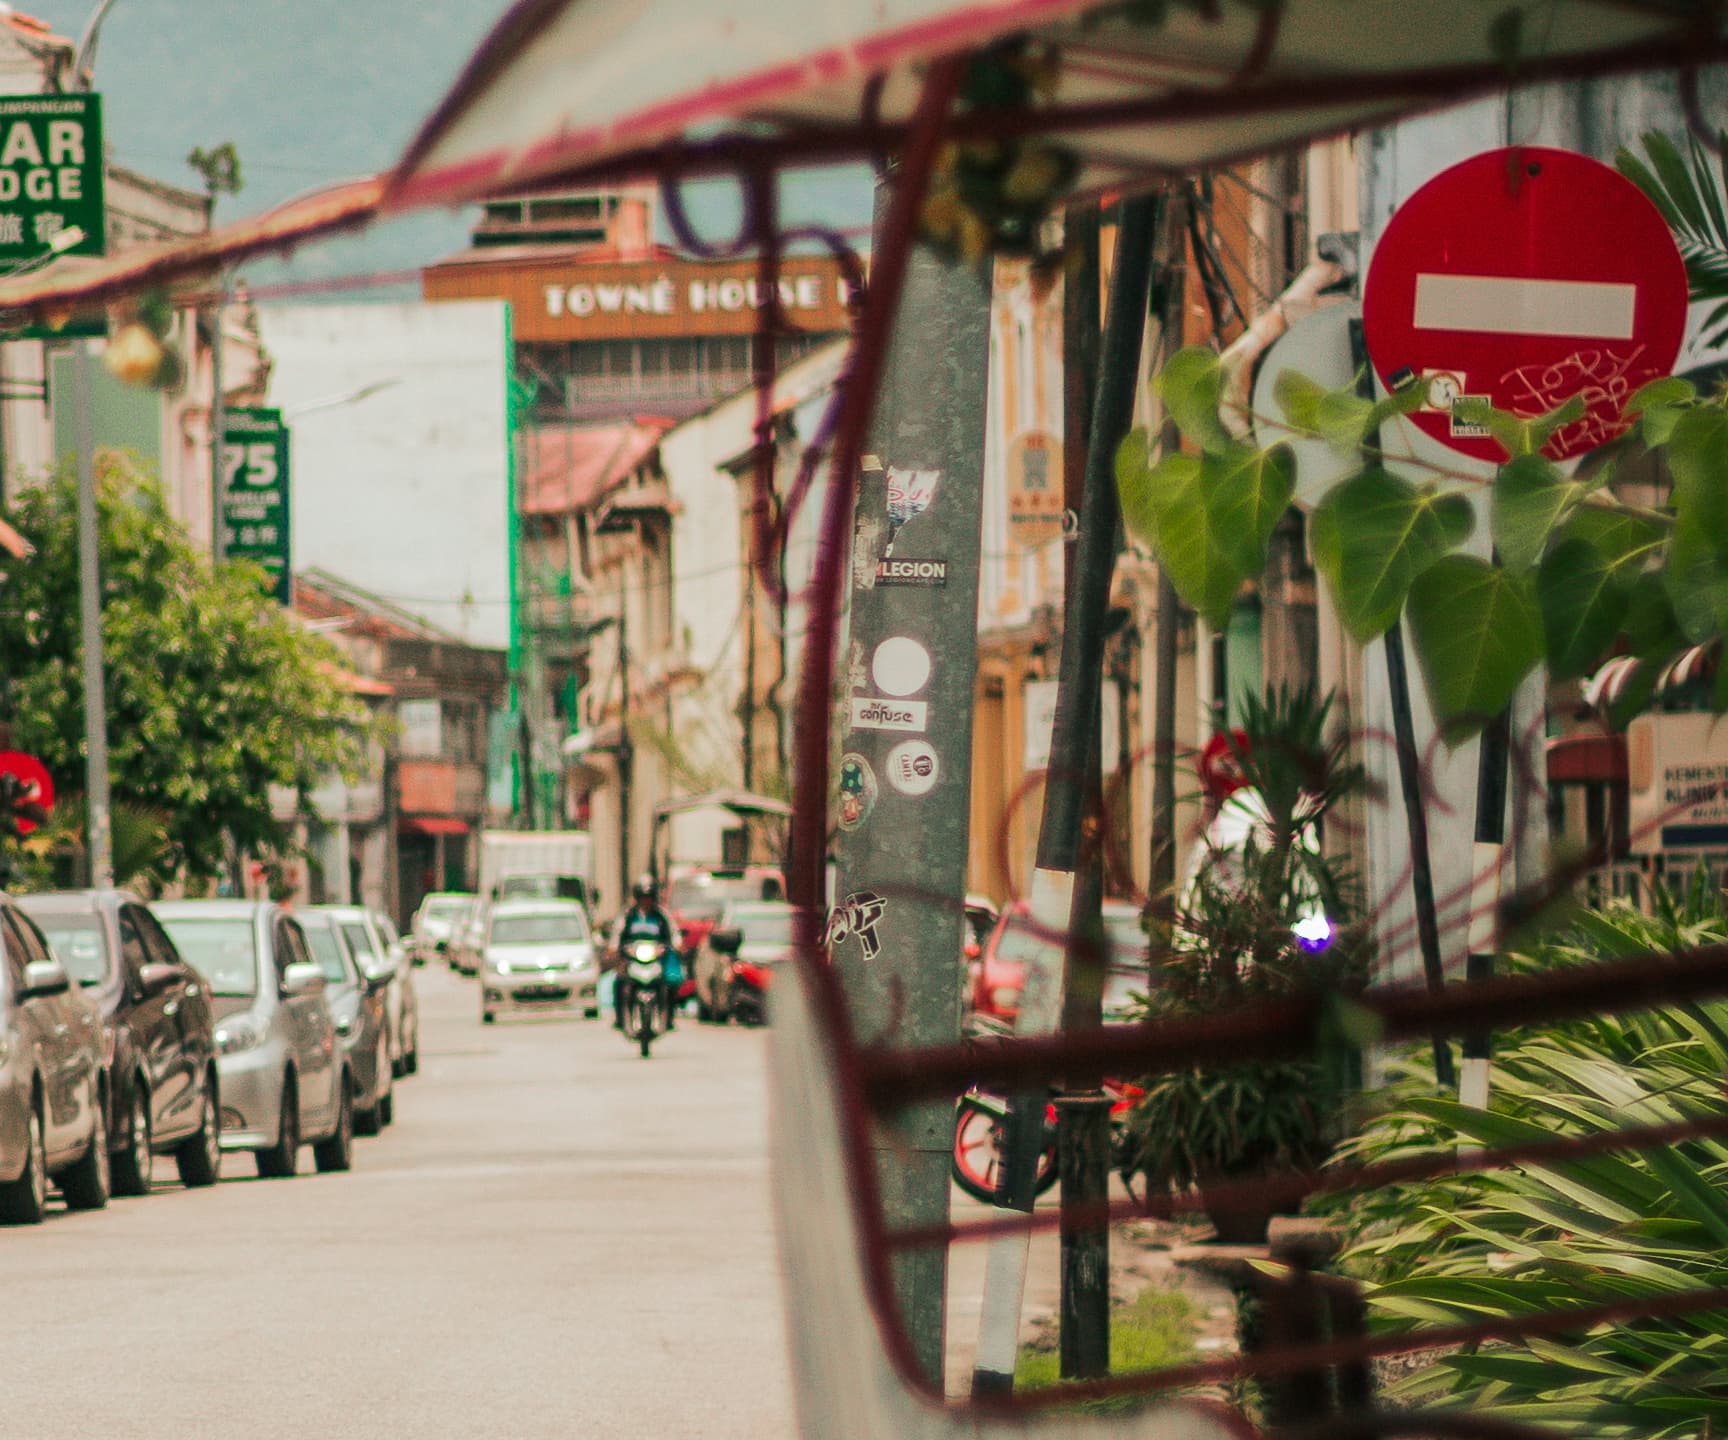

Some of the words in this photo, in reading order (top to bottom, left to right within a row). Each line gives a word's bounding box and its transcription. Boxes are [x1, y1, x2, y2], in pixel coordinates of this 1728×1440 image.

[543, 275, 675, 317] TOWNE
[222, 443, 278, 486] 75
[883, 562, 945, 577] LEGION
